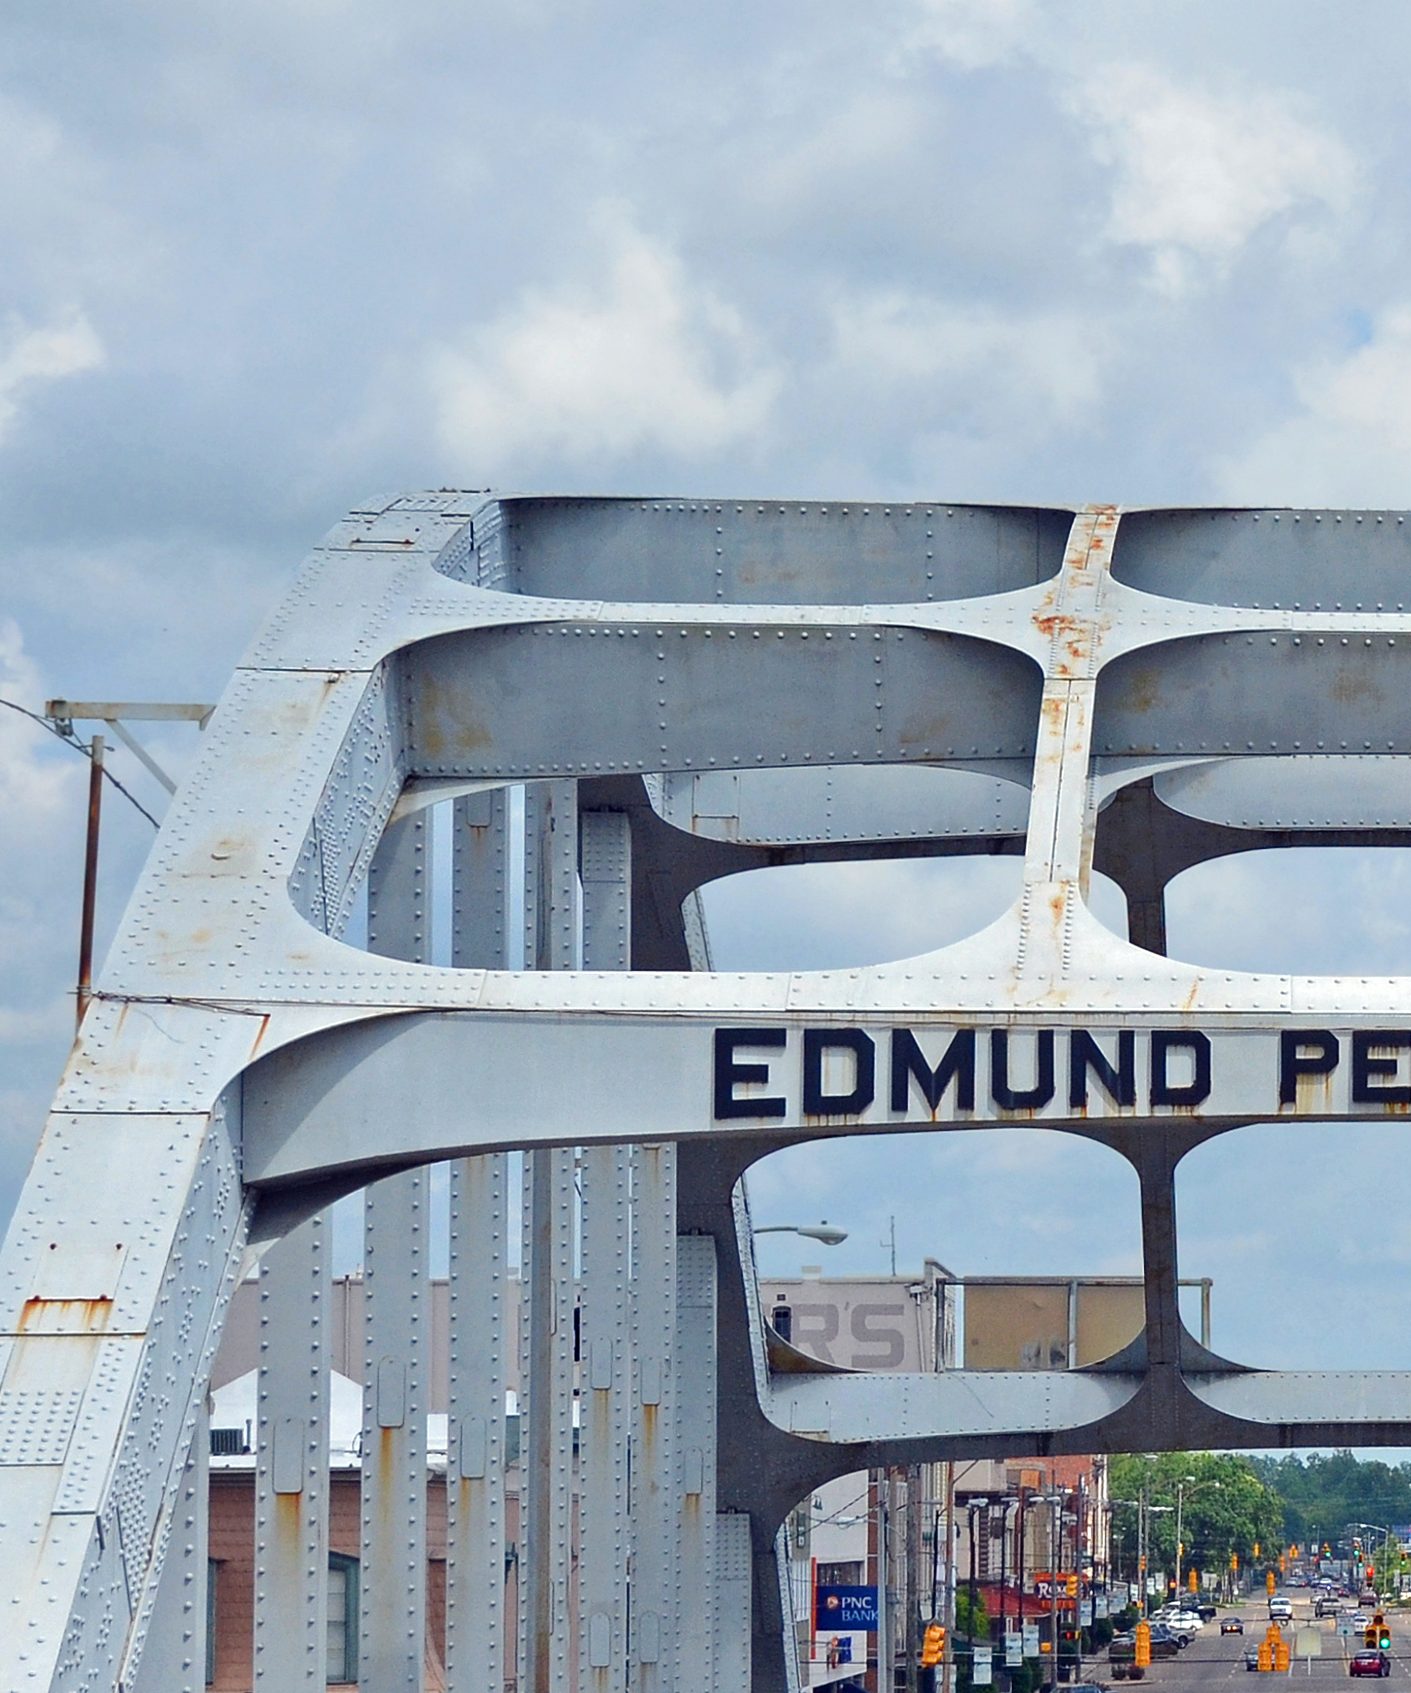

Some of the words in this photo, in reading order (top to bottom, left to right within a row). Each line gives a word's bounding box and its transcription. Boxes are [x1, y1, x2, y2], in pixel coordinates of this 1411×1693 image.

[714, 1027, 1212, 1120] EDMUND
[841, 1596, 872, 1609] PNC
[841, 1610, 879, 1621] BANK
